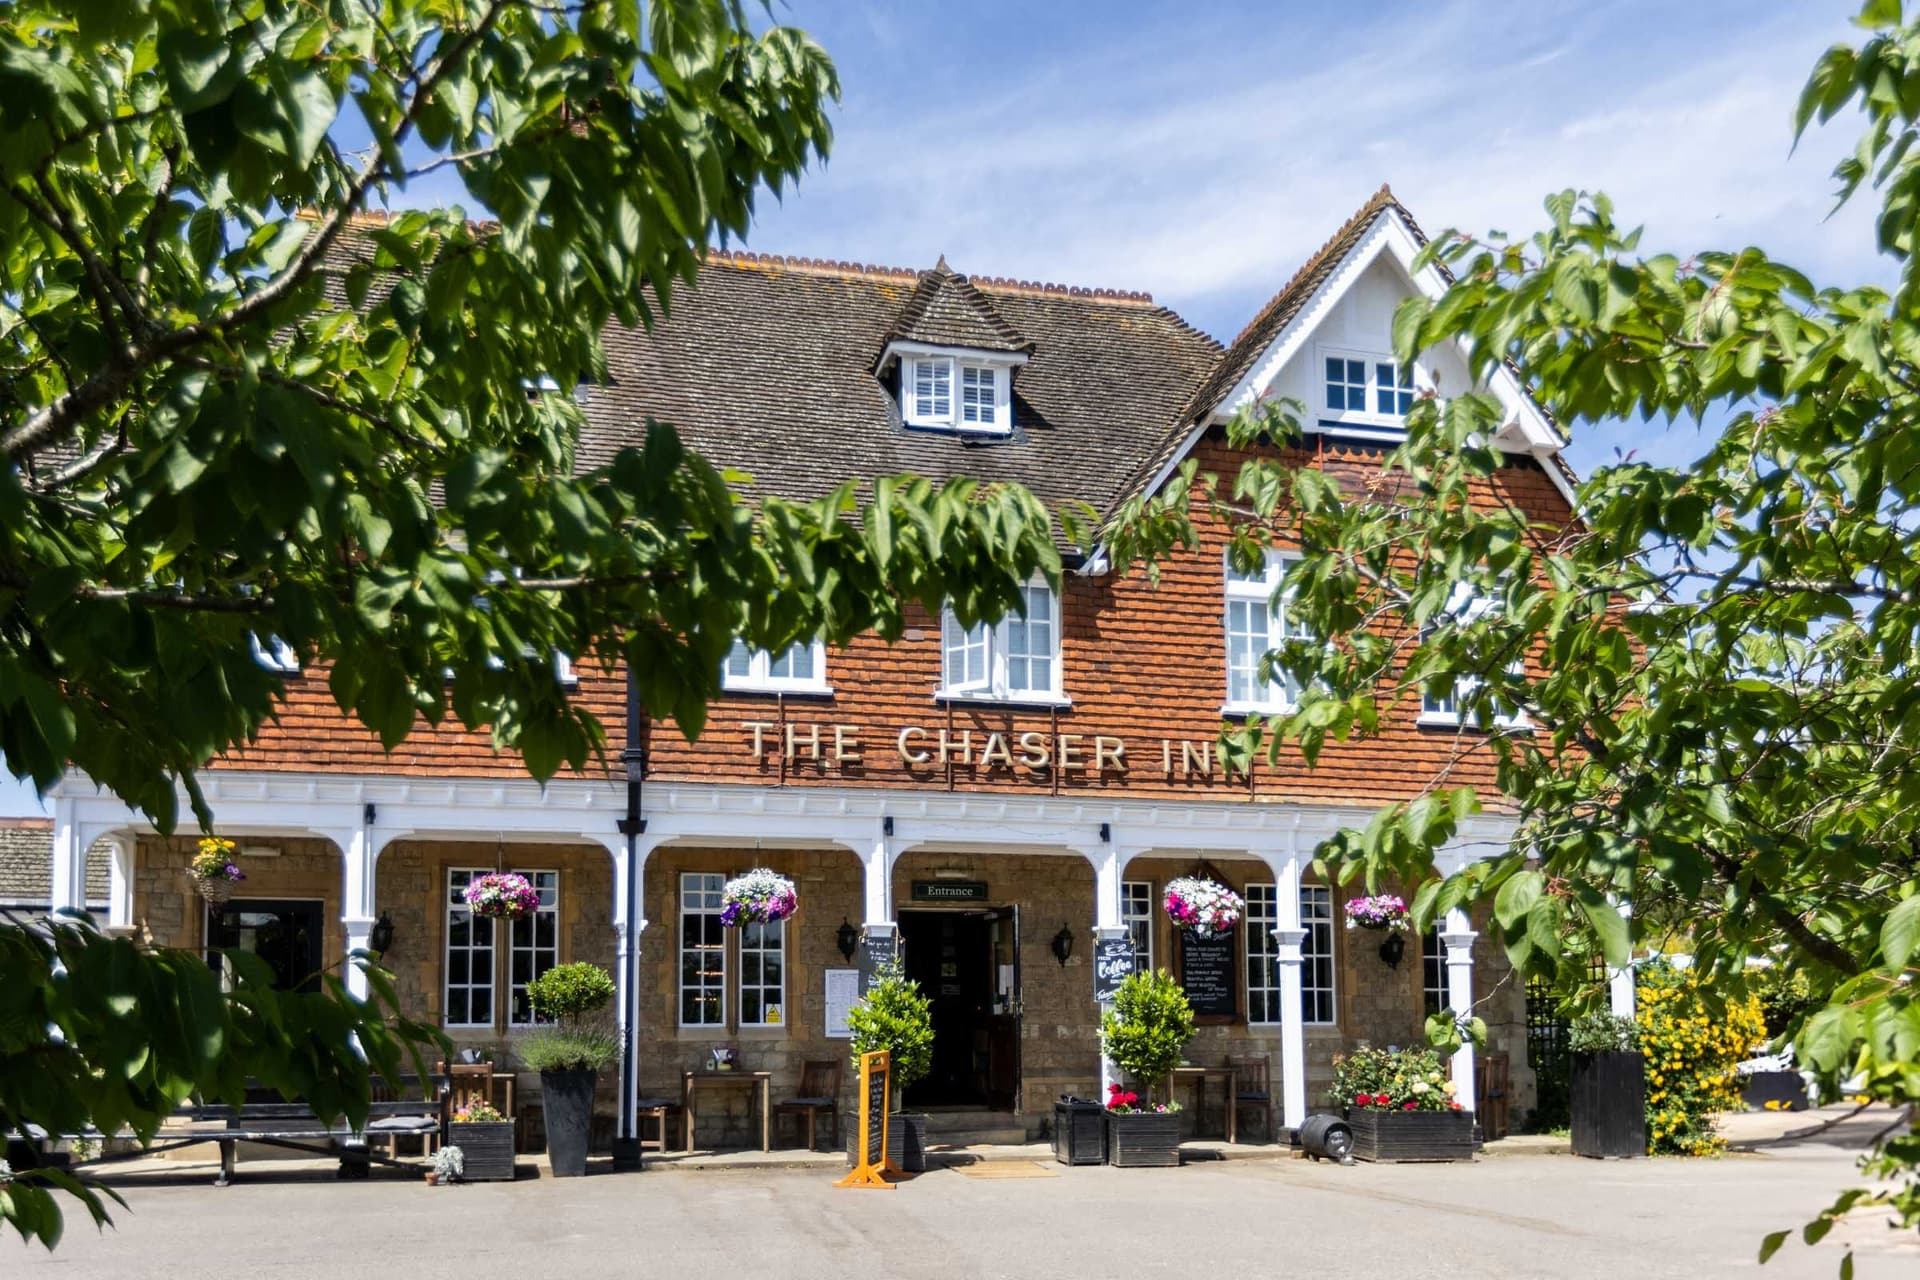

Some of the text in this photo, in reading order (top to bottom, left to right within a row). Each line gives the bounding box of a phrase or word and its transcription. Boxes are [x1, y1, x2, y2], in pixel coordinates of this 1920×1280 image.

[741, 722, 1248, 780] THE CHASER IN
[927, 886, 974, 897] Entrance
[1098, 958, 1132, 979] Coffee
